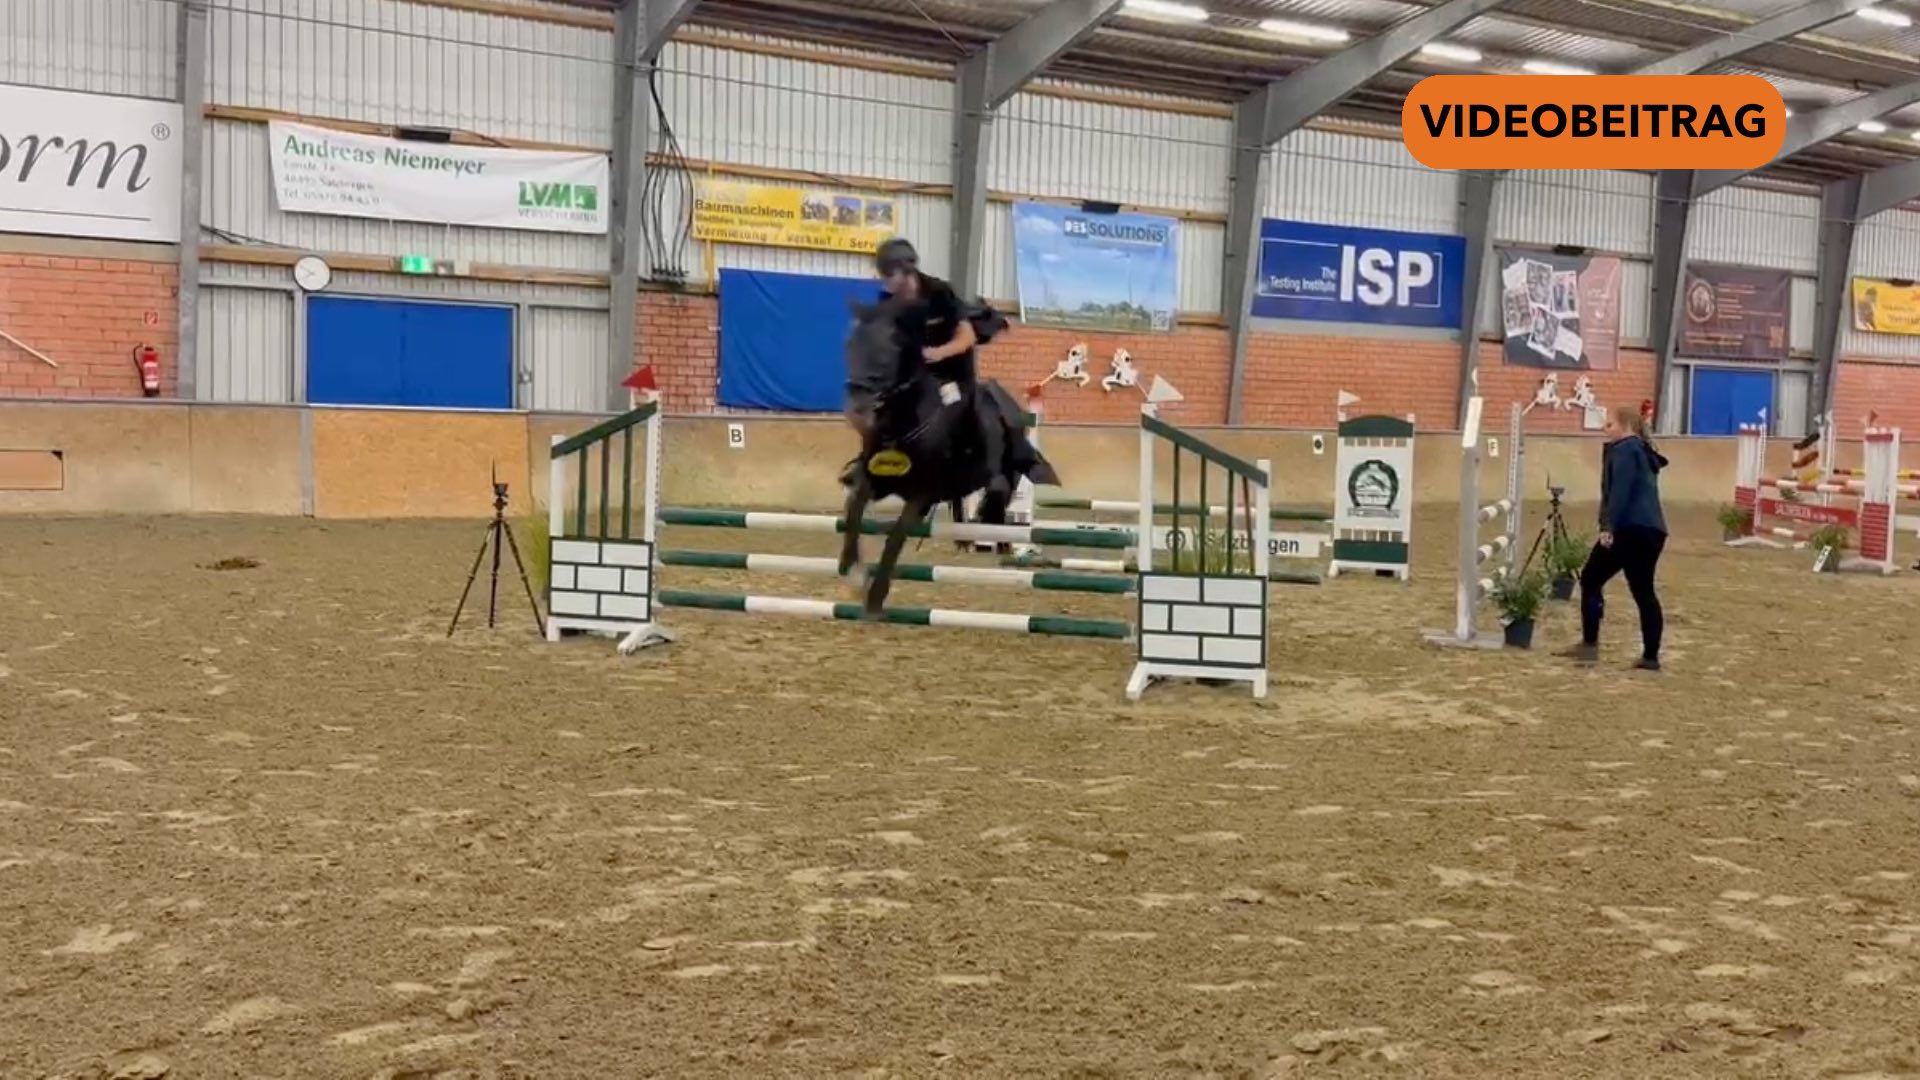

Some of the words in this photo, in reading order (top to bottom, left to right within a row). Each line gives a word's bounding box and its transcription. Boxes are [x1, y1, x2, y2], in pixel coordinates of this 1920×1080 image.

[283, 134, 376, 164] Andreas
[384, 147, 487, 178] Niemeyer
[518, 181, 571, 208] LVM
[695, 200, 795, 219] Baumaschinen
[1088, 221, 1165, 242] SOLUTIONS
[849, 238, 877, 250] Serv
[1320, 266, 1337, 280] The
[1340, 244, 1434, 306] ISP
[1270, 275, 1300, 292] Testing
[1302, 278, 1337, 292] Institute
[731, 428, 742, 443] B
[1204, 532, 1299, 555] Slzbgen
